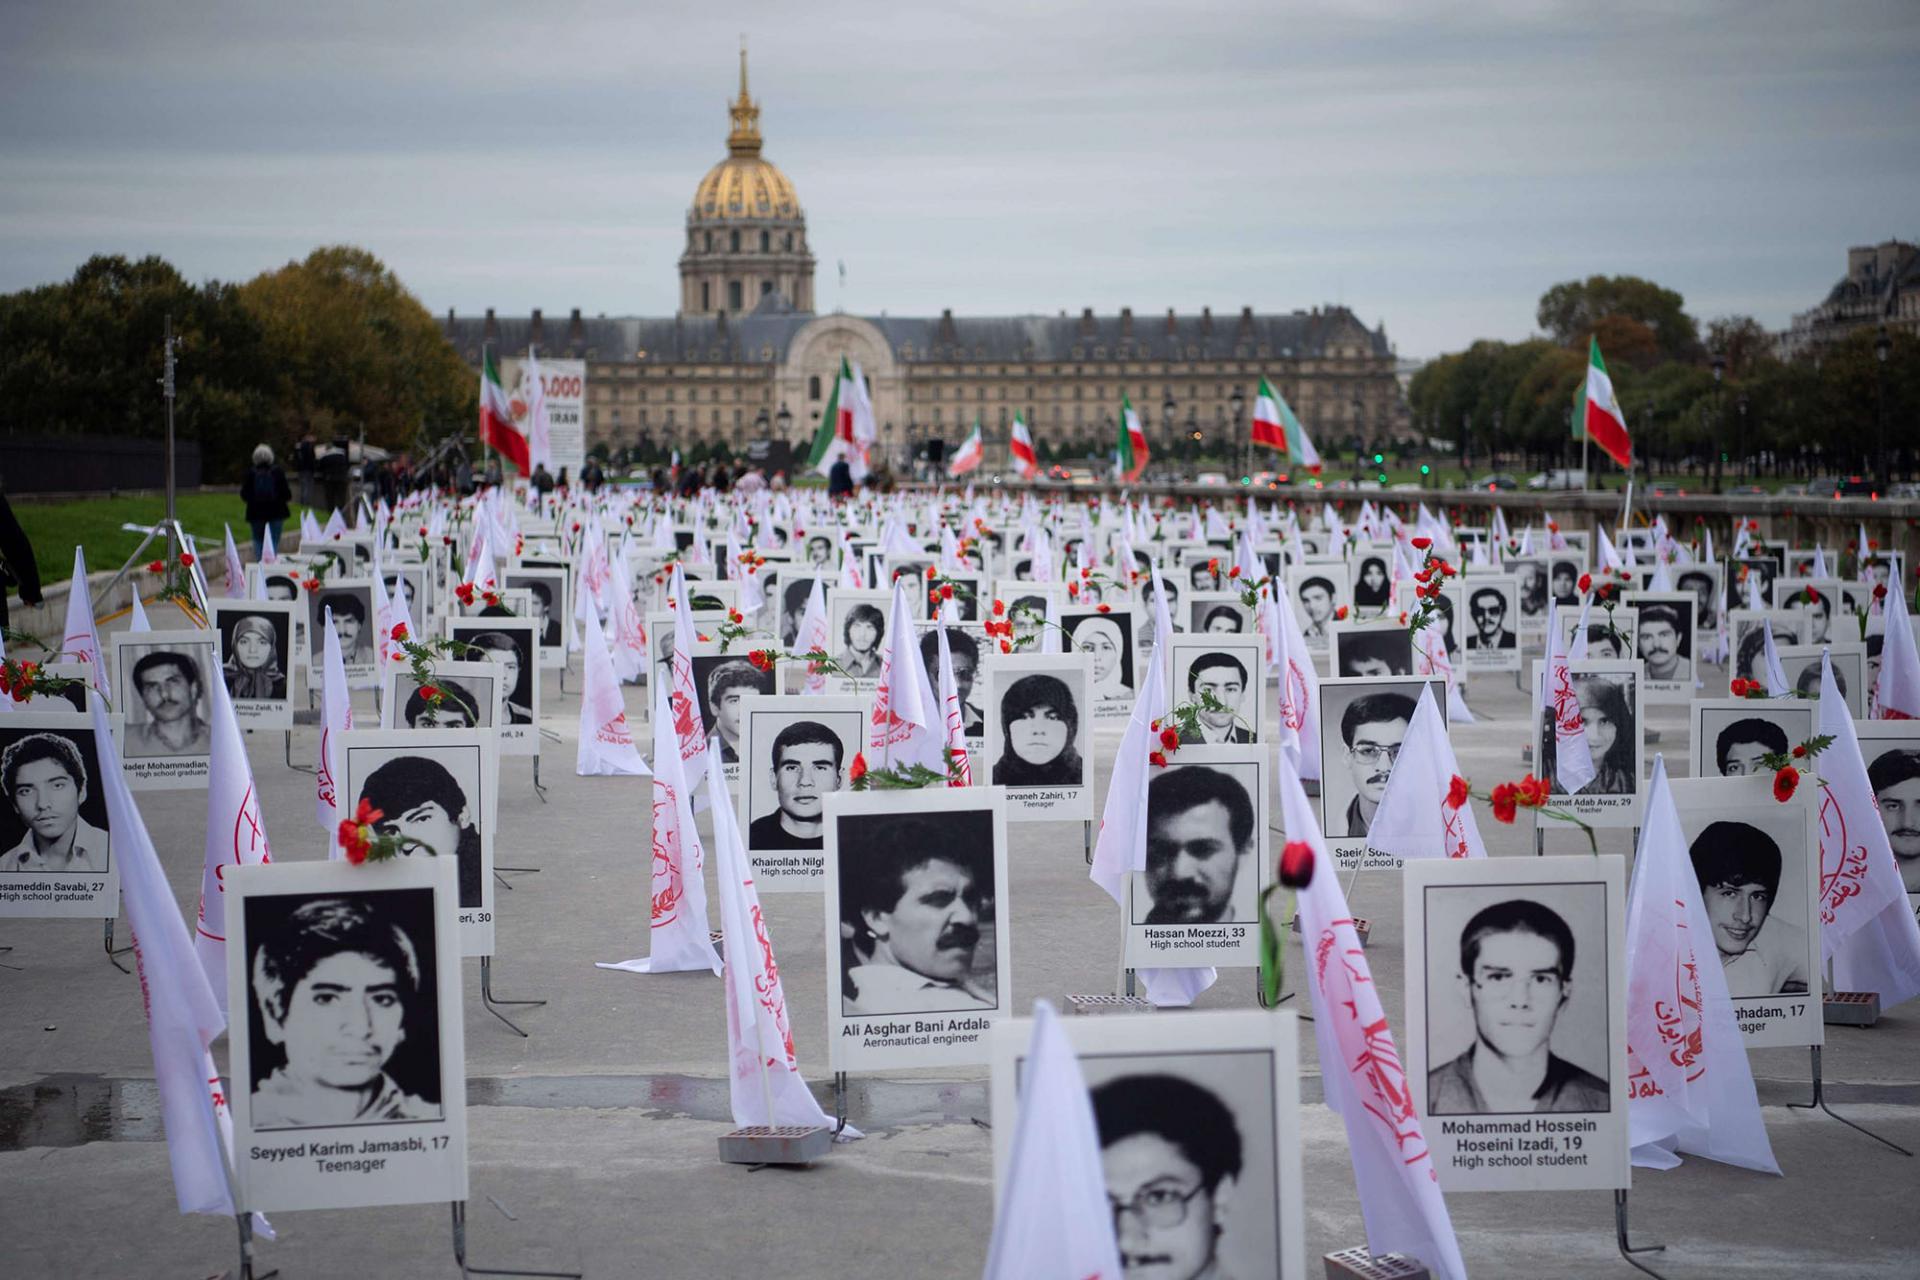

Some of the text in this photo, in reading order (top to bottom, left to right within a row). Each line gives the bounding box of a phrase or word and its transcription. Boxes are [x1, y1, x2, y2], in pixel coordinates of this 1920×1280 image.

[550, 413, 579, 424] IRAN
[147, 761, 209, 770] Mohammadian,
[135, 771, 152, 779] High
[178, 769, 207, 777] graduate
[1040, 792, 1065, 801] Zahiri,
[1067, 791, 1077, 799] 17
[1574, 798, 1595, 806] Adab
[1597, 798, 1619, 807] Avaz,
[1621, 798, 1631, 806] 29
[752, 858, 799, 867] Khairollah
[1364, 858, 1394, 866] school
[761, 868, 780, 877] High
[782, 868, 808, 876] school
[54, 882, 89, 892] Savabi,
[92, 883, 104, 891] 27
[0, 893, 94, 902] High school graduate
[478, 913, 491, 922] 30
[1145, 928, 1245, 939] Hassan Moezzi, 33
[1150, 939, 1240, 950] High school student
[1790, 1005, 1805, 1016] 17
[842, 1024, 860, 1036] Ali
[864, 1022, 911, 1037] Asghar
[915, 1020, 944, 1032] Bani
[863, 1033, 979, 1048] Aeronautical engineer
[1442, 1118, 1597, 1134] Mohammad Hossein
[250, 1136, 450, 1162] Seyyed Karim Jamasbi, 17
[1457, 1136, 1582, 1152] Hoseini Izadi, 19
[316, 1159, 386, 1173] Teenager
[1453, 1153, 1587, 1169] High school student
